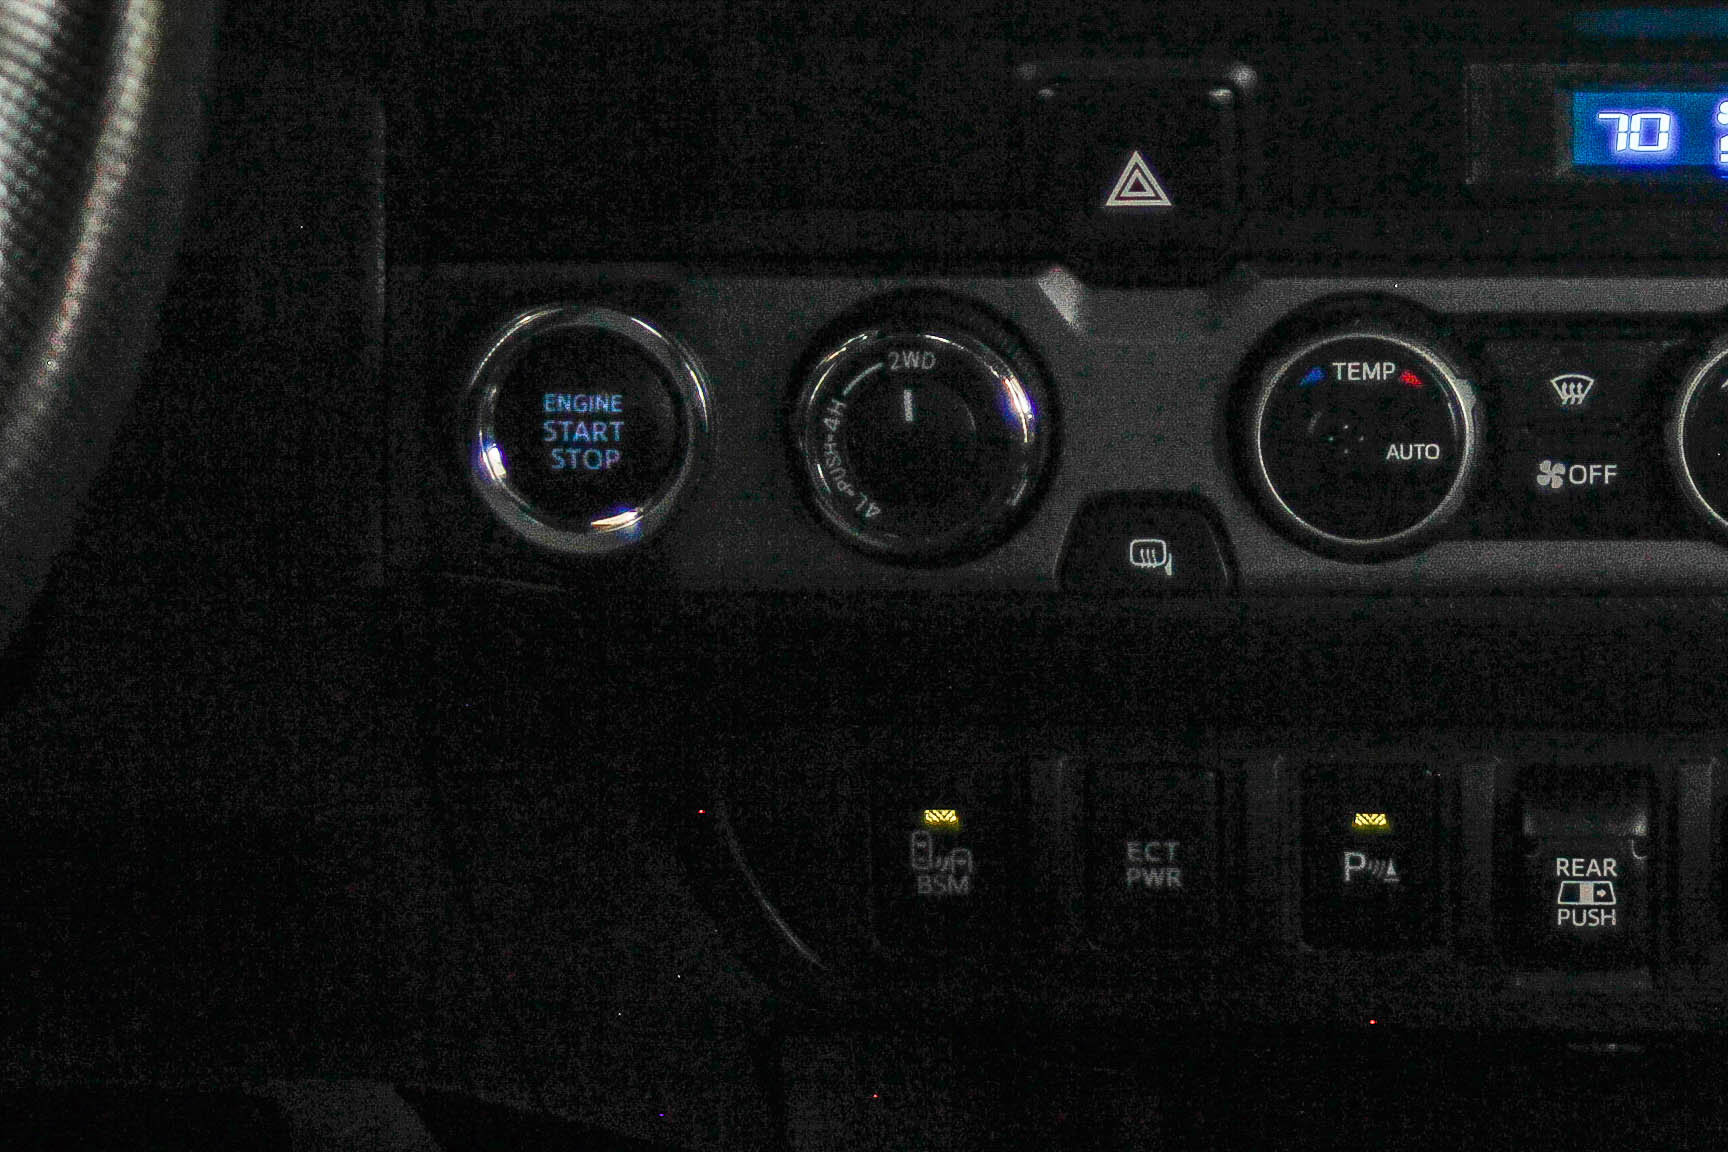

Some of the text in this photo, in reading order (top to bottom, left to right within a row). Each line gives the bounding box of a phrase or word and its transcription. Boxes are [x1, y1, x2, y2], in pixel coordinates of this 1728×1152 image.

[1598, 110, 1672, 153] 70
[887, 350, 937, 372] 2WD
[1332, 361, 1396, 382] TEMP
[542, 393, 624, 414] ENGINE
[542, 421, 626, 443] START
[551, 449, 622, 470] STOP
[1385, 443, 1441, 461] AUTO
[1568, 464, 1618, 485] OFF
[1126, 842, 1178, 862] ECT
[1126, 867, 1180, 888] PWR
[1555, 857, 1618, 878] REAR
[917, 874, 970, 896] BSM
[1557, 908, 1617, 928] PUSH
